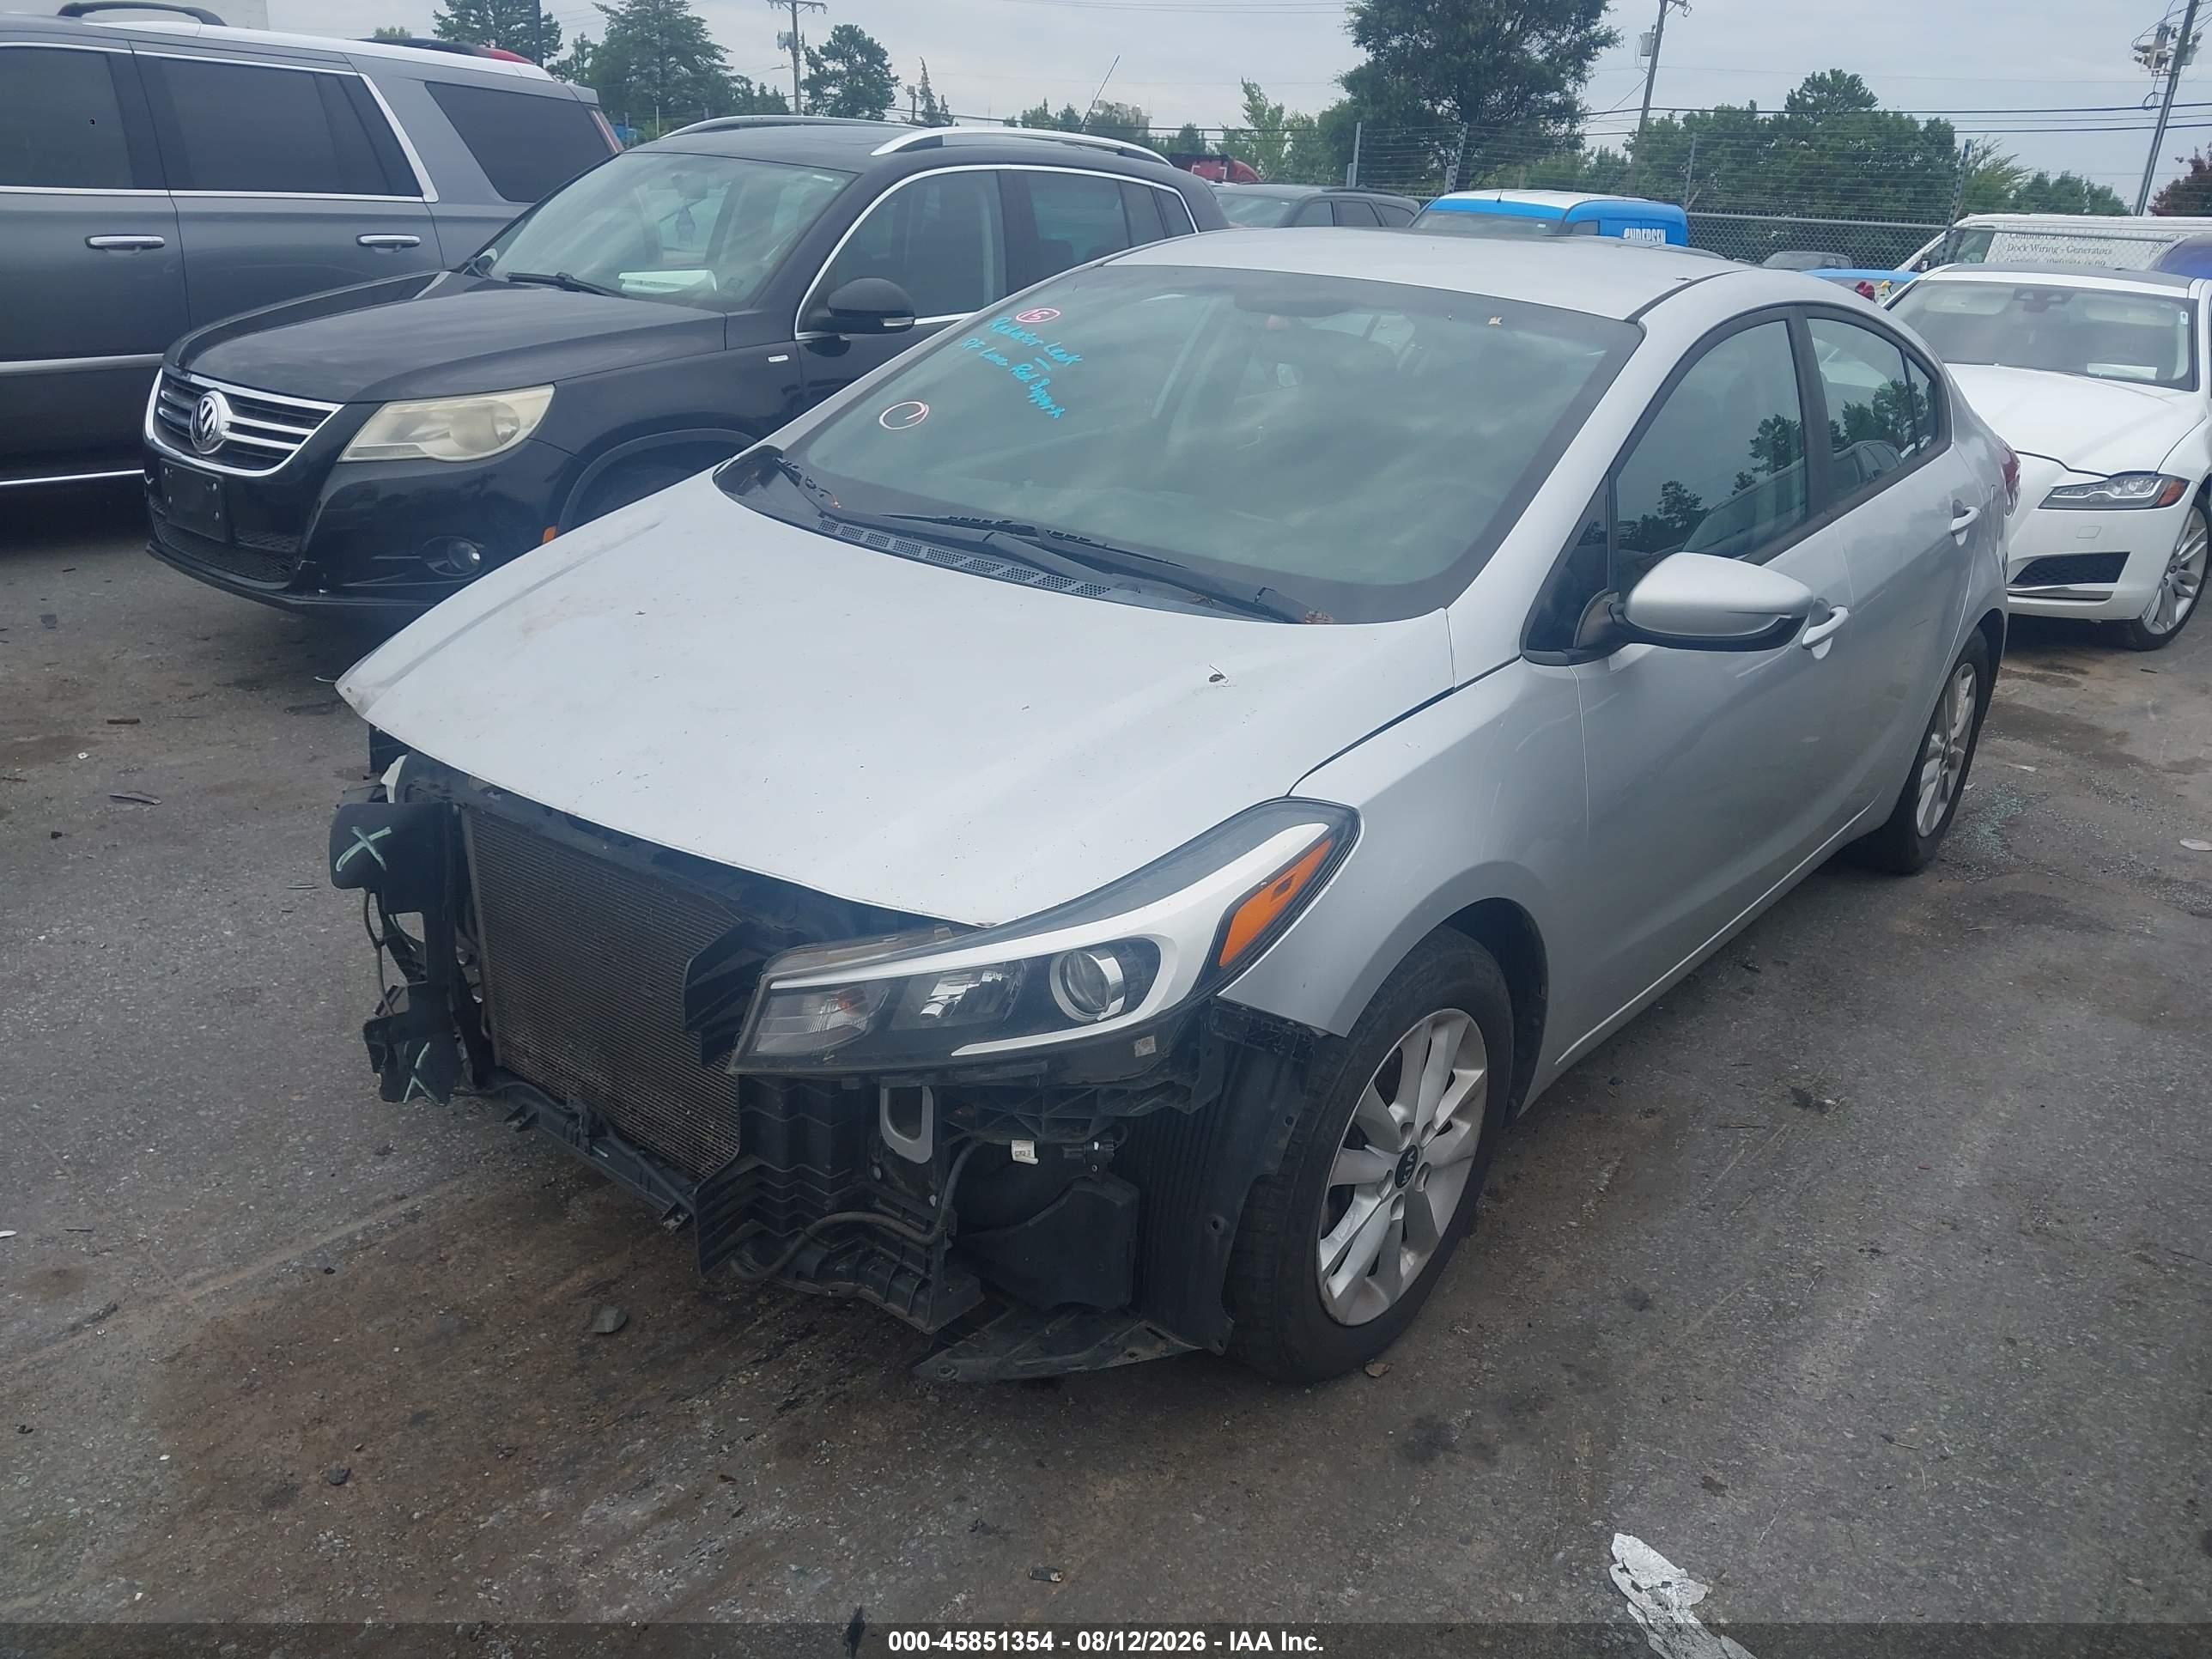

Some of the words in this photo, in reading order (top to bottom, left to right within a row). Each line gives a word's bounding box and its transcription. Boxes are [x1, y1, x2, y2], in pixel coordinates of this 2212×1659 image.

[2007, 243, 2027, 252] Dock
[2030, 244, 2058, 254] Wiring
[2066, 246, 2112, 255] Generators
